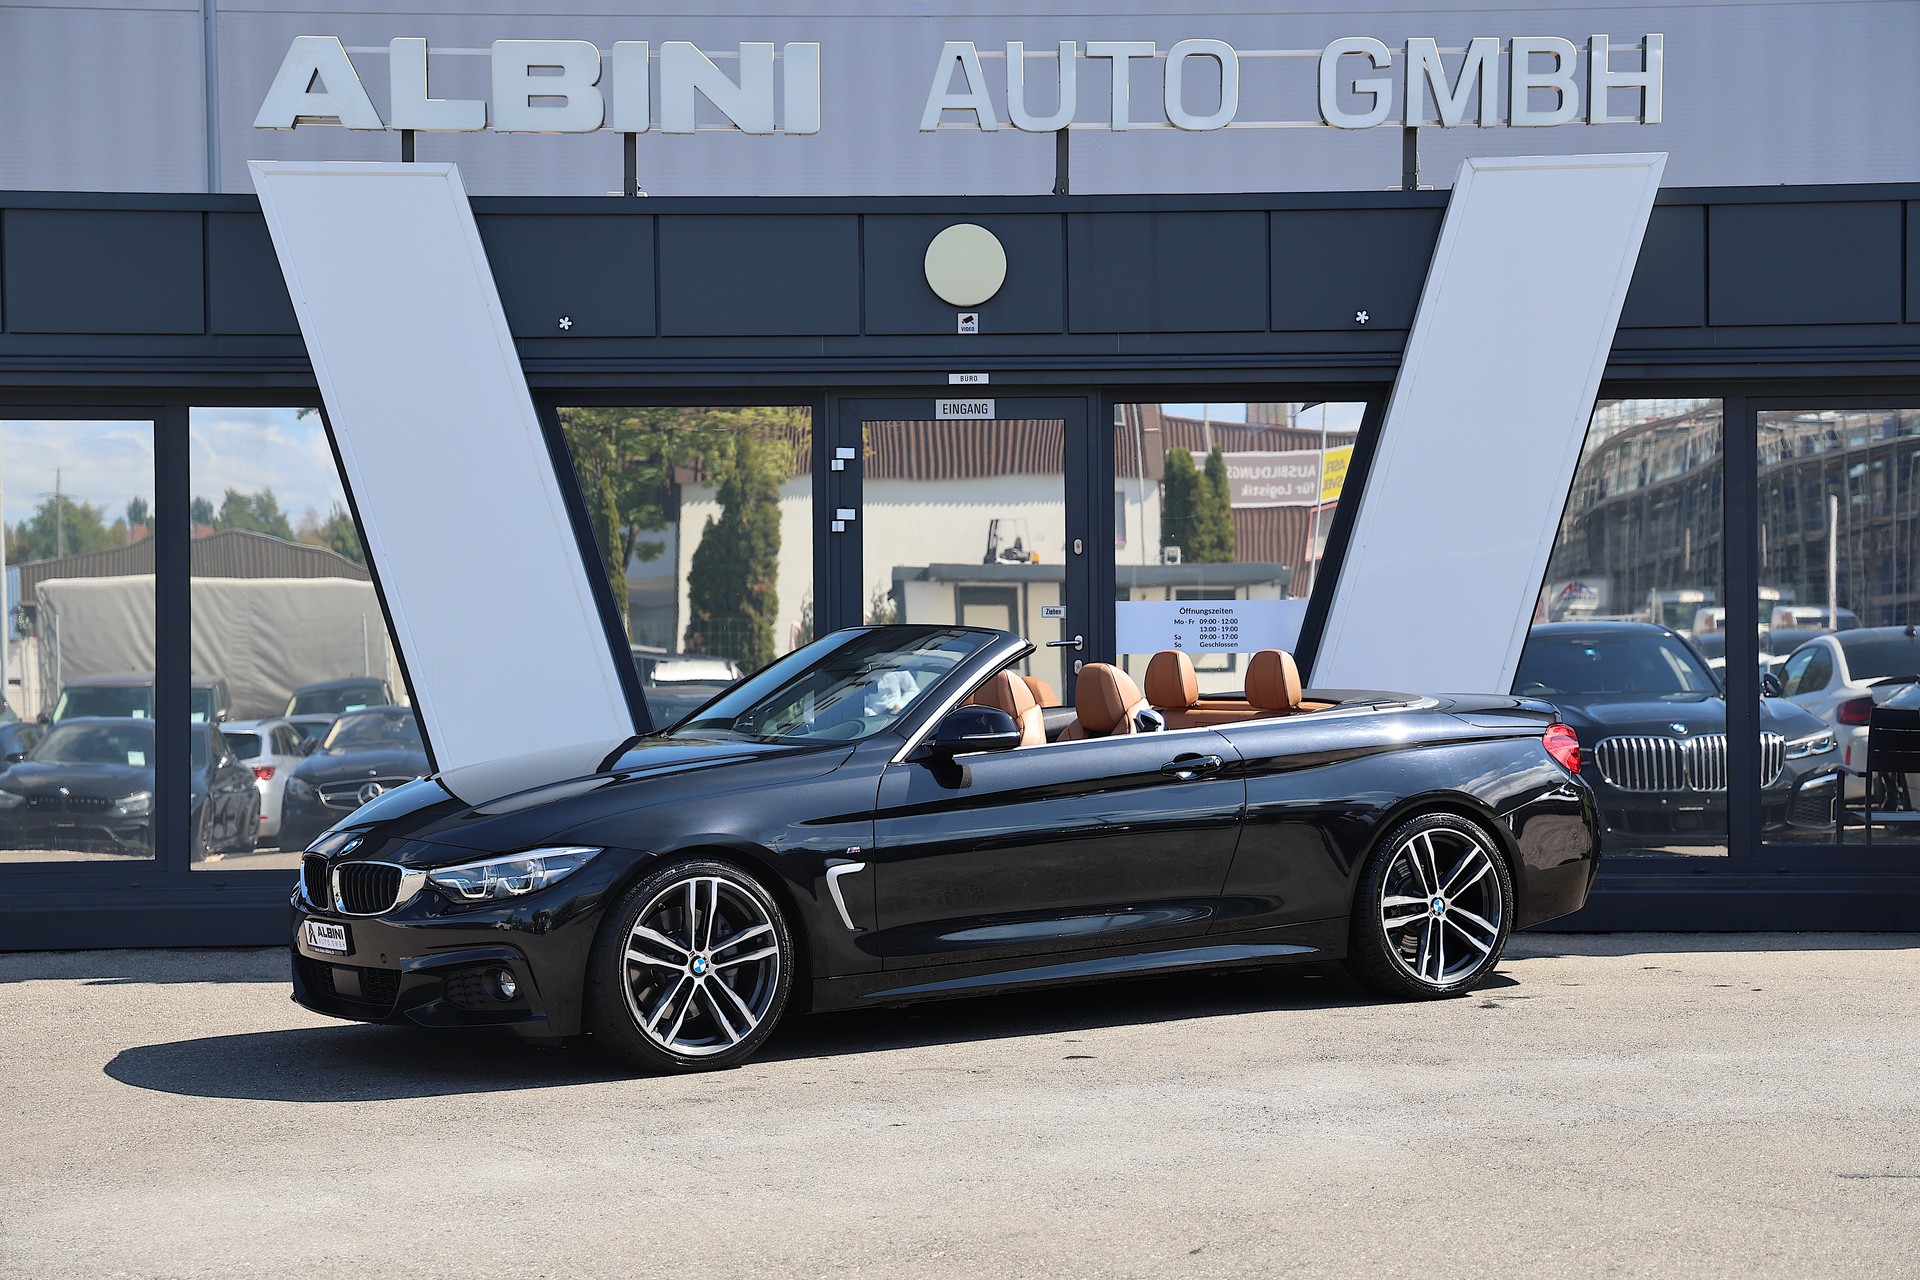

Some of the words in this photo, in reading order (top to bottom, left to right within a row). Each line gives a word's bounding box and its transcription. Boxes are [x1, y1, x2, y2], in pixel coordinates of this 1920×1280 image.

[252, 35, 821, 135] ALBINI
[919, 38, 1239, 133] AUTO
[1320, 32, 1664, 129] GMBH
[942, 403, 988, 415] EINGANG
[1179, 607, 1234, 615] Öffnungszeiten
[317, 926, 344, 940] ALBINI
